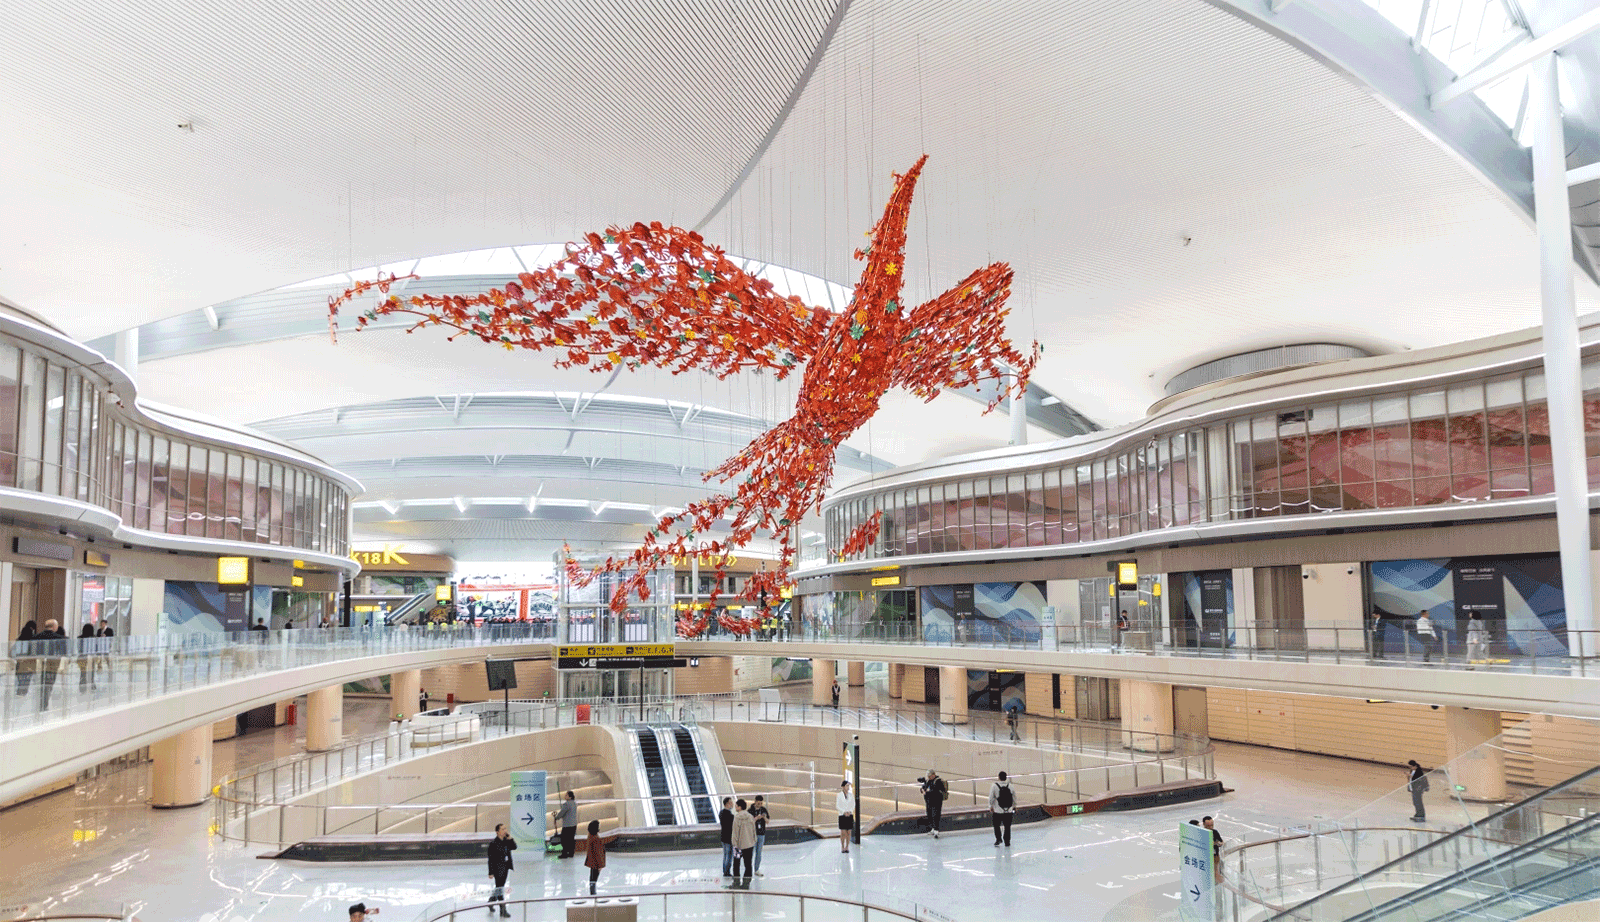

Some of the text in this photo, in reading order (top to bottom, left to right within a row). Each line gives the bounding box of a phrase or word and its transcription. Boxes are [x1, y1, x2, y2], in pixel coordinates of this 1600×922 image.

[516, 794, 540, 802] 会场区
[1184, 855, 1206, 872] 会场区
